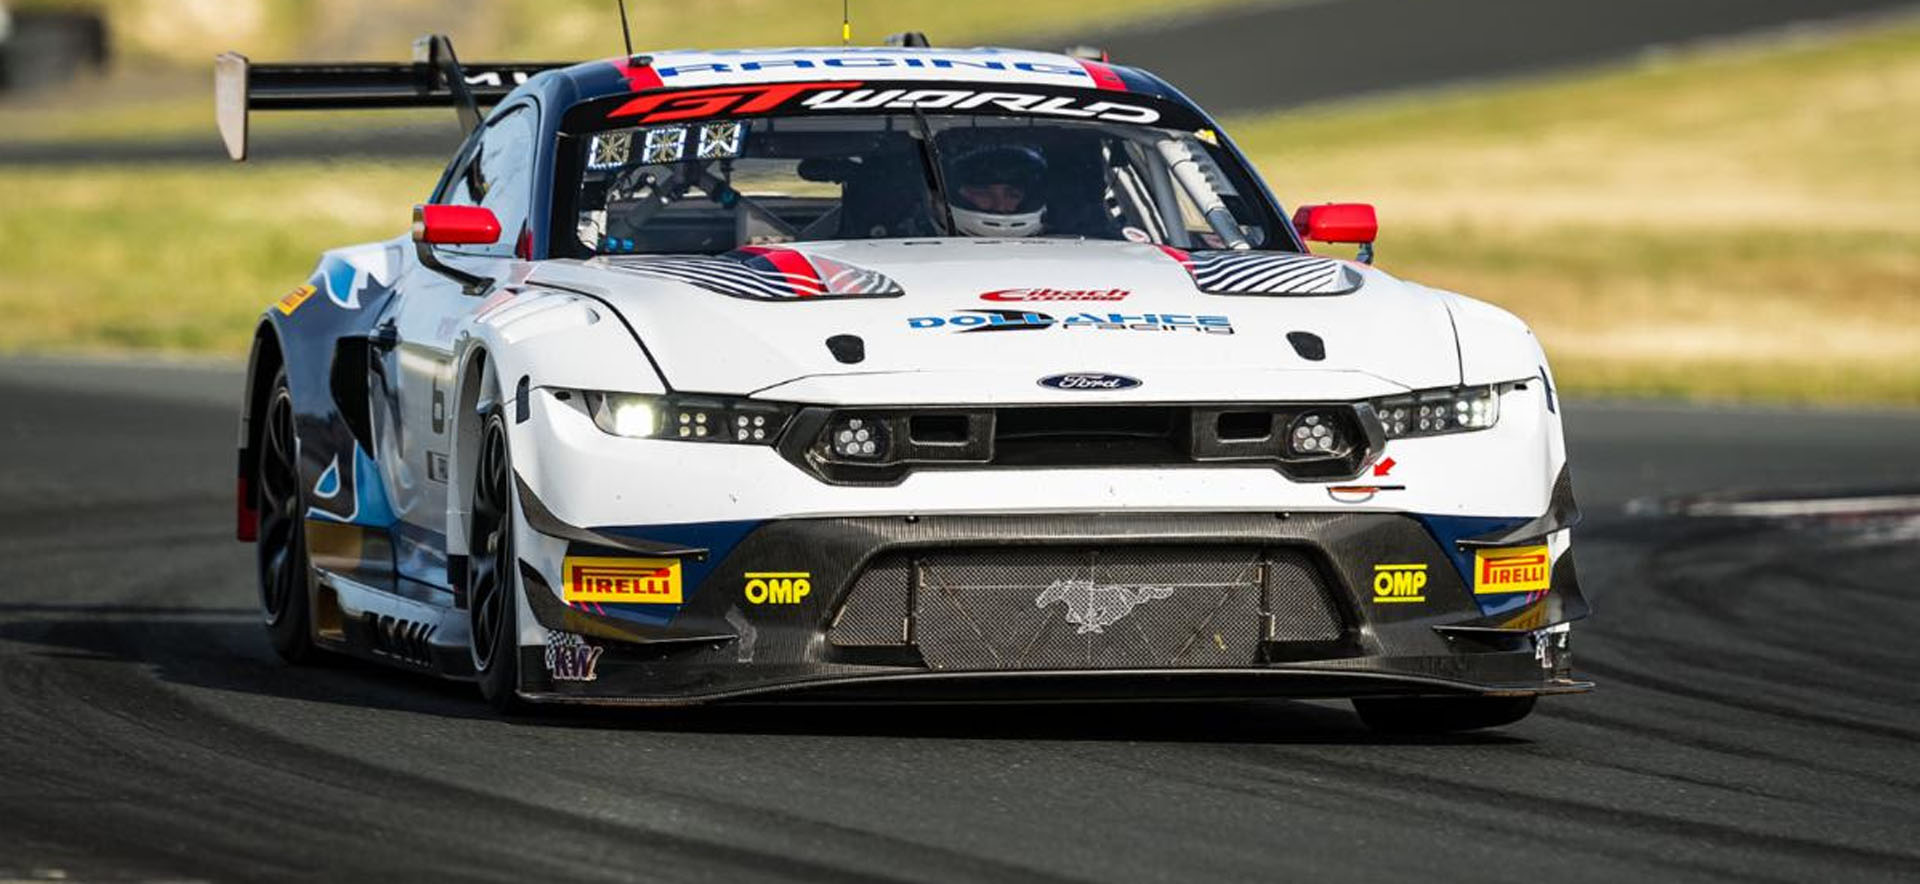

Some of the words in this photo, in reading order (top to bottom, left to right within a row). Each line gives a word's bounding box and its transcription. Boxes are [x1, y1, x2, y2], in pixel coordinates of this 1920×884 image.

[656, 58, 1087, 78] RACING
[801, 89, 1161, 125] WORLD
[1059, 374, 1121, 389] Ford
[572, 564, 671, 595] PIRELLI
[1482, 554, 1546, 585] PIRELLI
[744, 578, 811, 605] OMP
[1373, 571, 1428, 597] OMP
